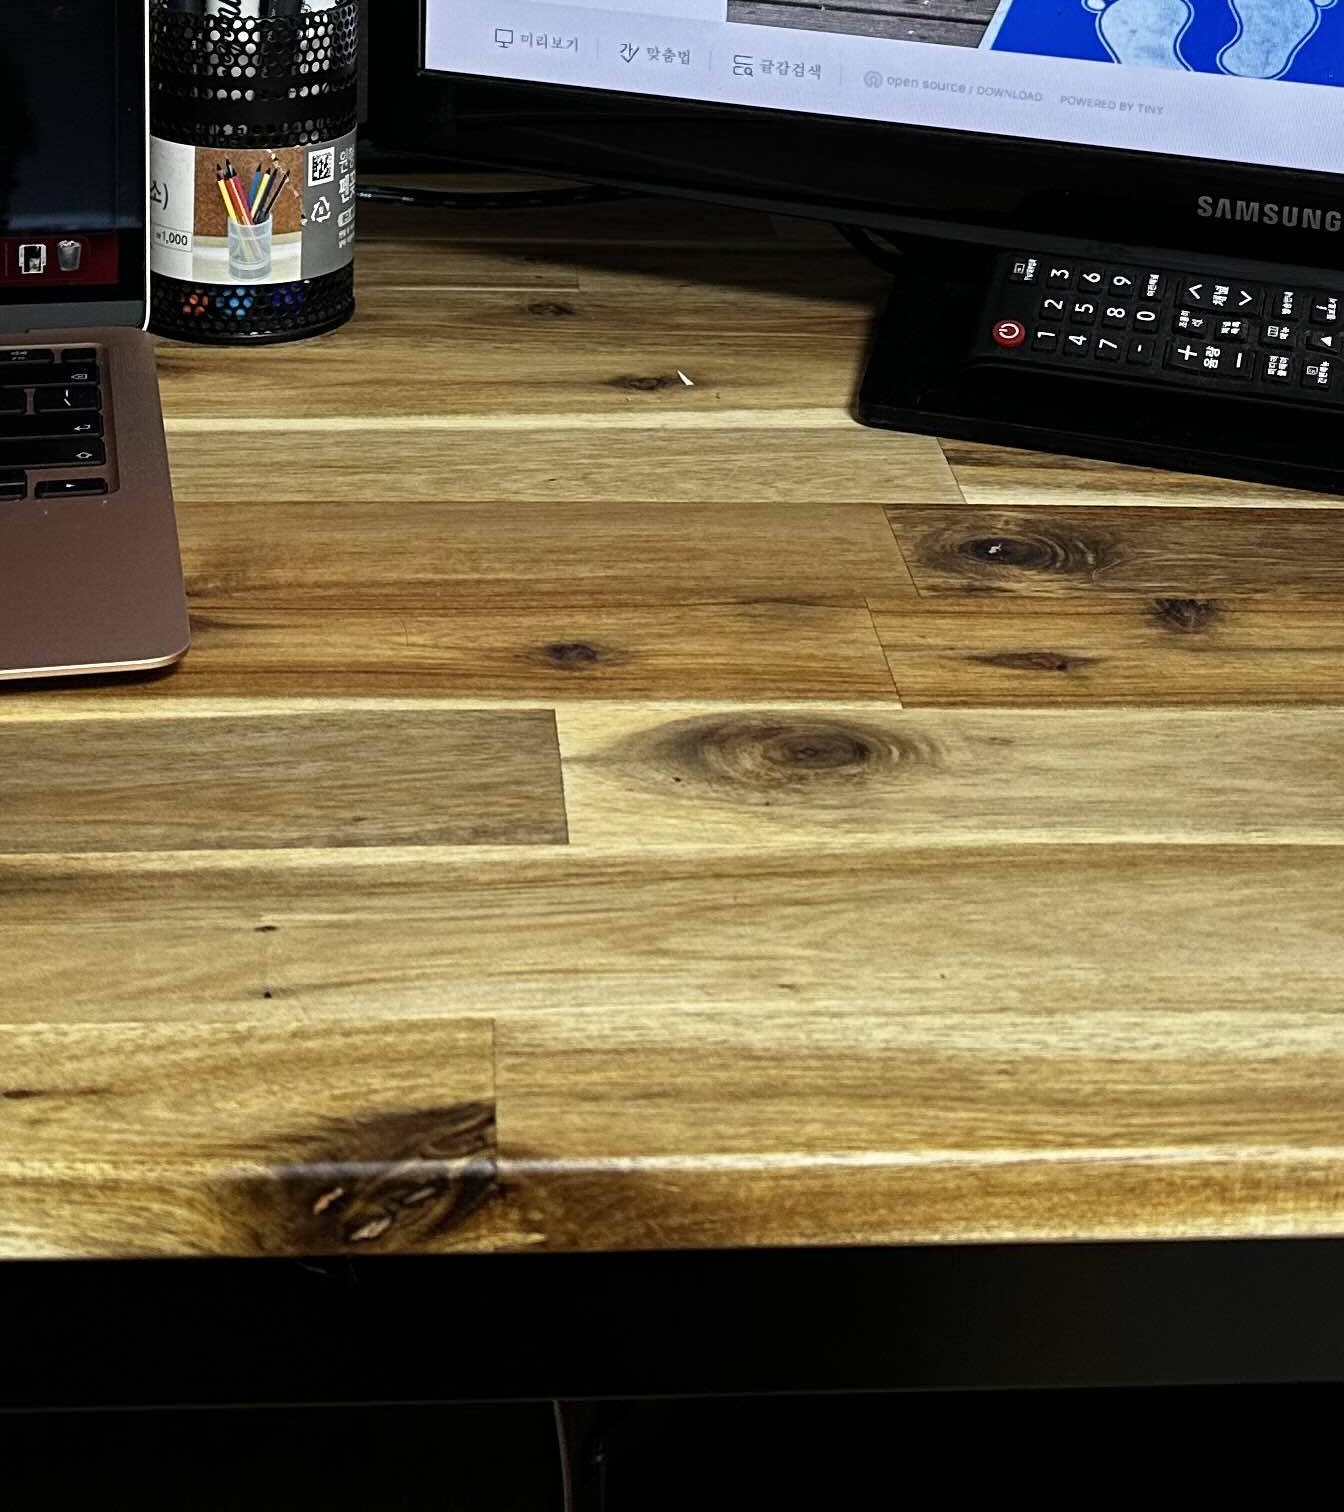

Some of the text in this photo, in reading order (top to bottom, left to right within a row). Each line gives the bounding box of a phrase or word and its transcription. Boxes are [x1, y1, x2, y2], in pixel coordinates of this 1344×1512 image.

[520, 32, 578, 51] 미리보기
[646, 46, 691, 65] 맞춤법
[759, 59, 822, 79] 글감검색
[887, 76, 1043, 103] open source DOWNLOAD
[1060, 95, 1164, 116] POWERED BY TINY
[1196, 195, 1343, 233] SAMSUNG
[1050, 268, 1069, 280] 3
[1083, 271, 1101, 283] 6
[1113, 275, 1132, 286] 9
[1212, 284, 1230, 307] 채널
[1044, 298, 1063, 310] 2
[1074, 302, 1094, 314] 5
[1106, 307, 1126, 318] 8
[1136, 310, 1156, 322] 0
[1037, 330, 1056, 339] 1
[1068, 334, 1087, 346] 4
[1098, 338, 1118, 349] 7
[1203, 345, 1221, 369] 음량
